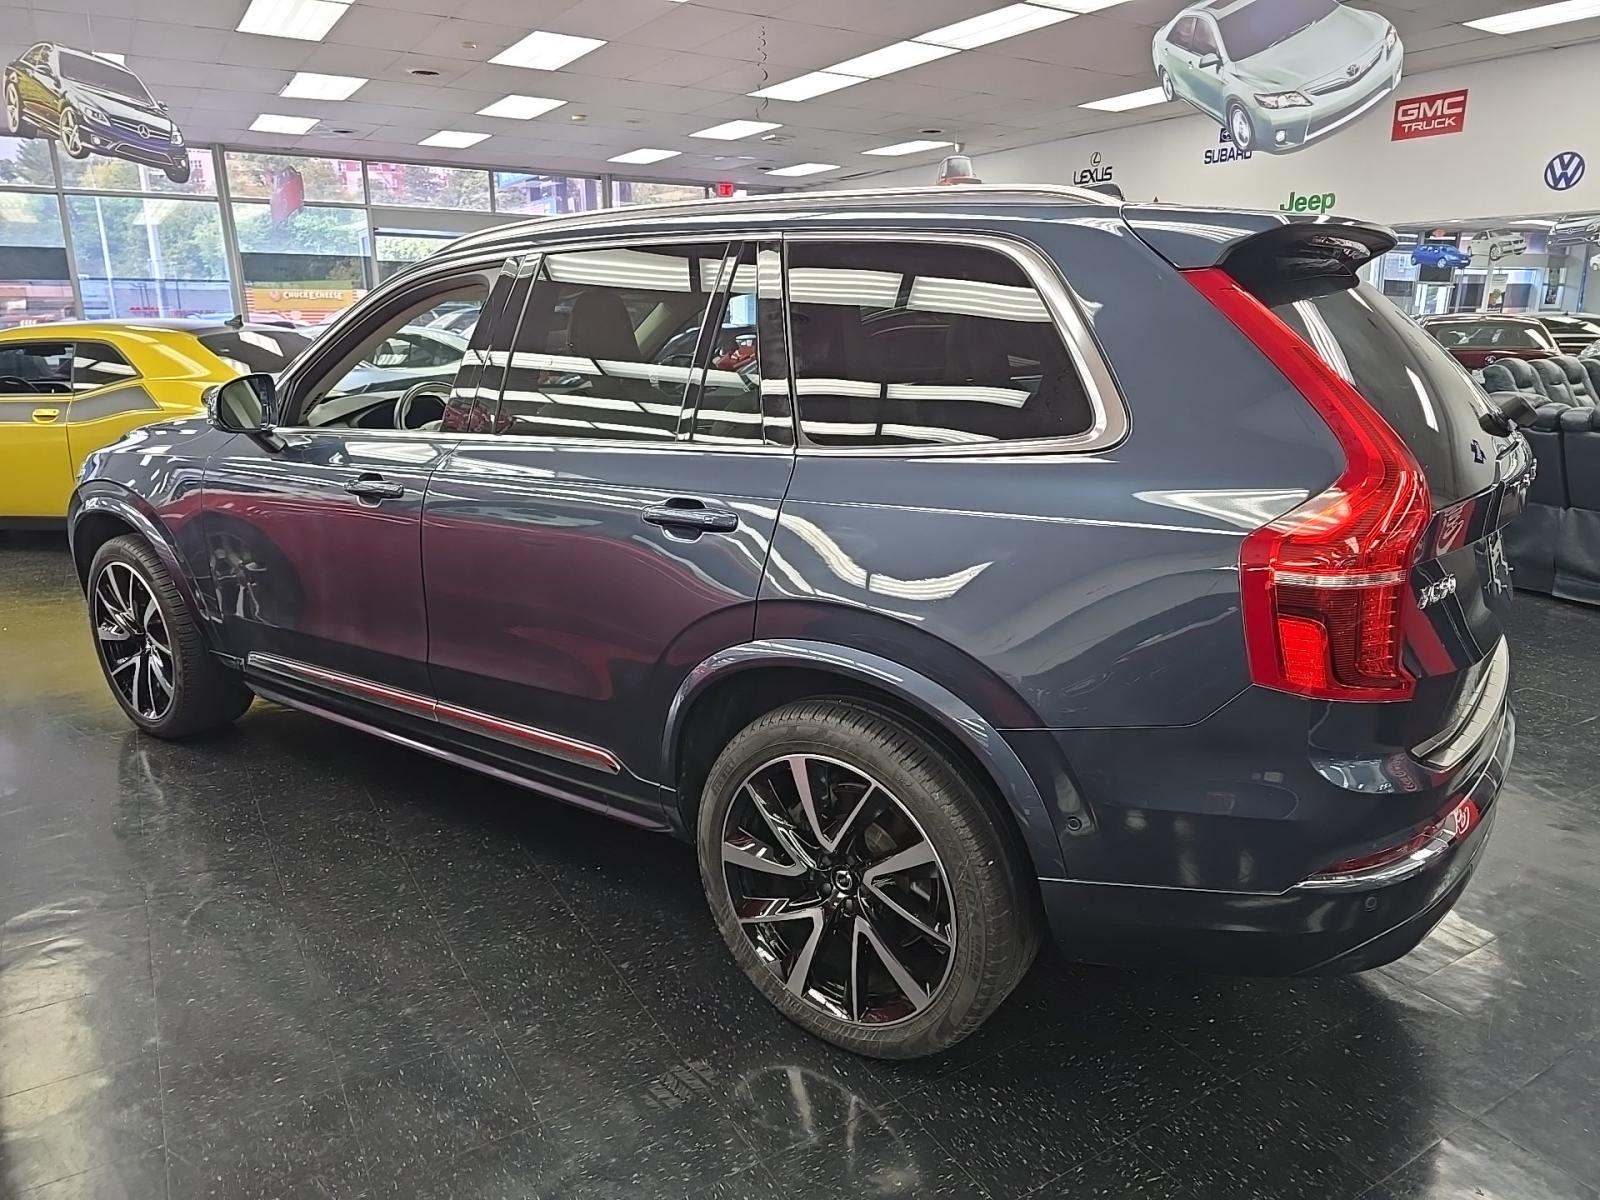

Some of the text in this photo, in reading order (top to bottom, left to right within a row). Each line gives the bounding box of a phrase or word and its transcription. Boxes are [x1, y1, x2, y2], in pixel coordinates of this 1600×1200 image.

[1398, 96, 1465, 121] GMC
[1401, 117, 1457, 133] TRUCK
[1073, 166, 1113, 185] LEXUS
[1279, 191, 1336, 214] Jeep
